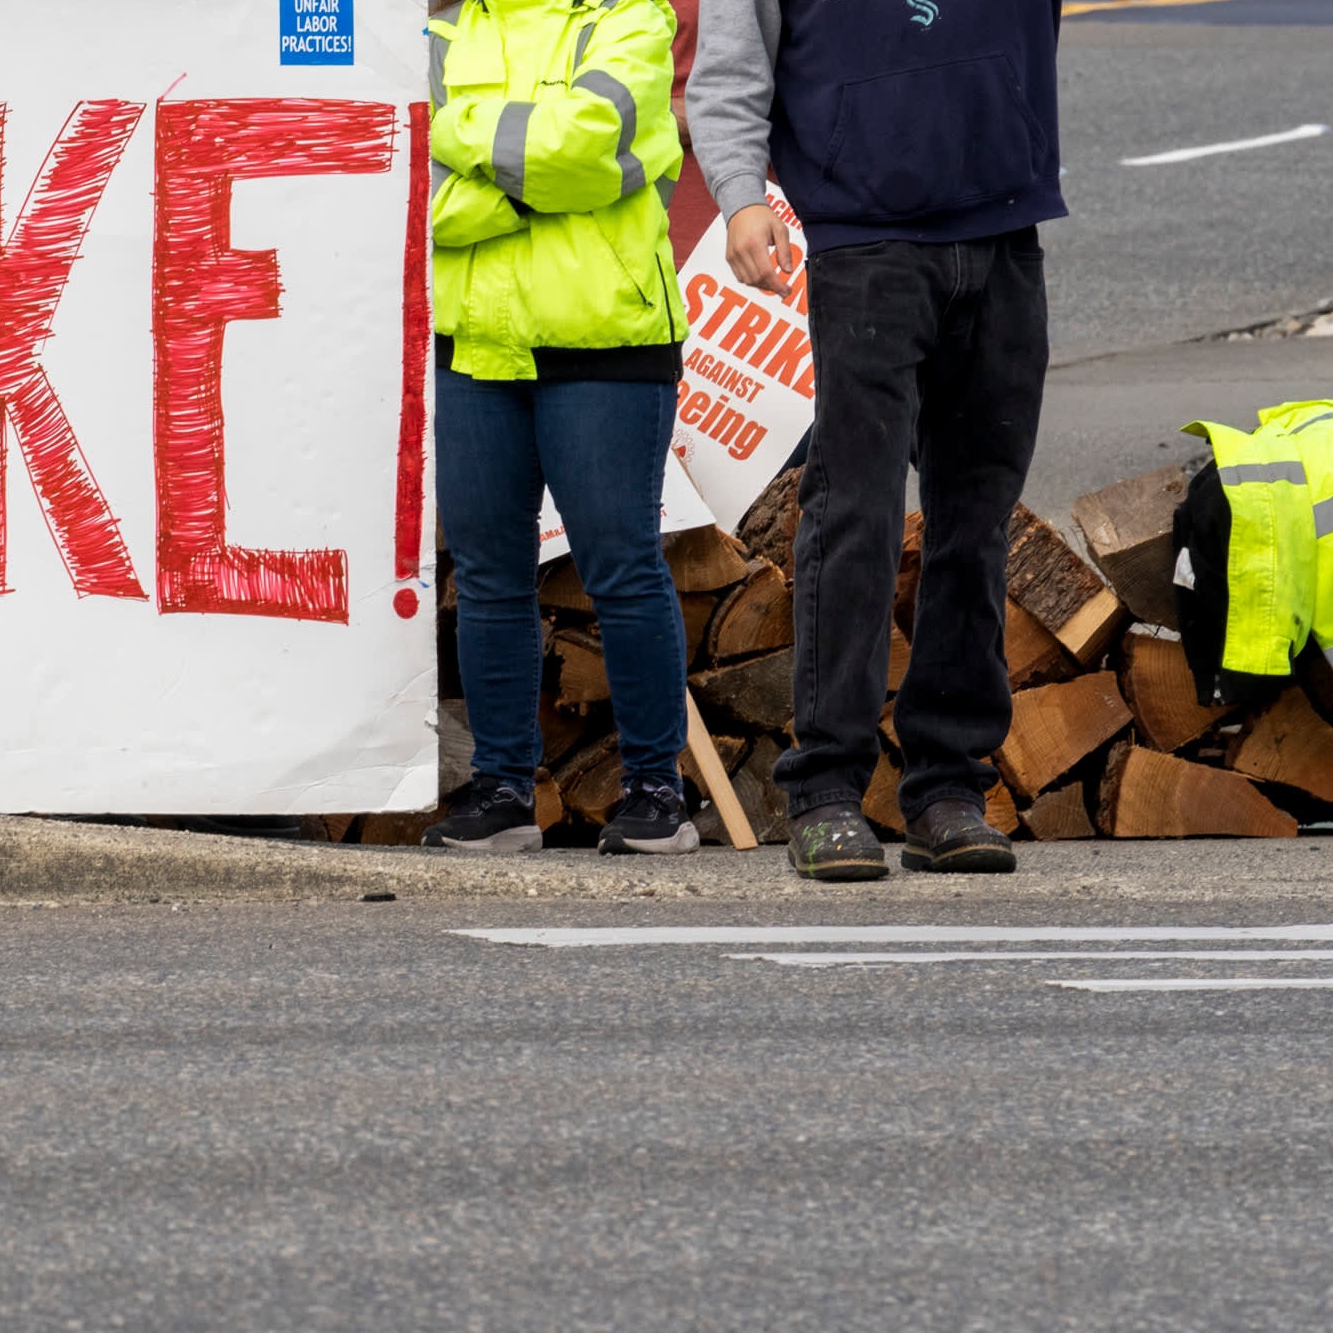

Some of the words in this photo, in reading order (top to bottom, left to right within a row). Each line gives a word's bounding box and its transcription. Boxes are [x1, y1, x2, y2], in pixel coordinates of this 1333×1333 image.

[297, 16, 337, 32] LABOR
[282, 36, 351, 52] PRACTICES!
[684, 347, 765, 404] AGAINST
